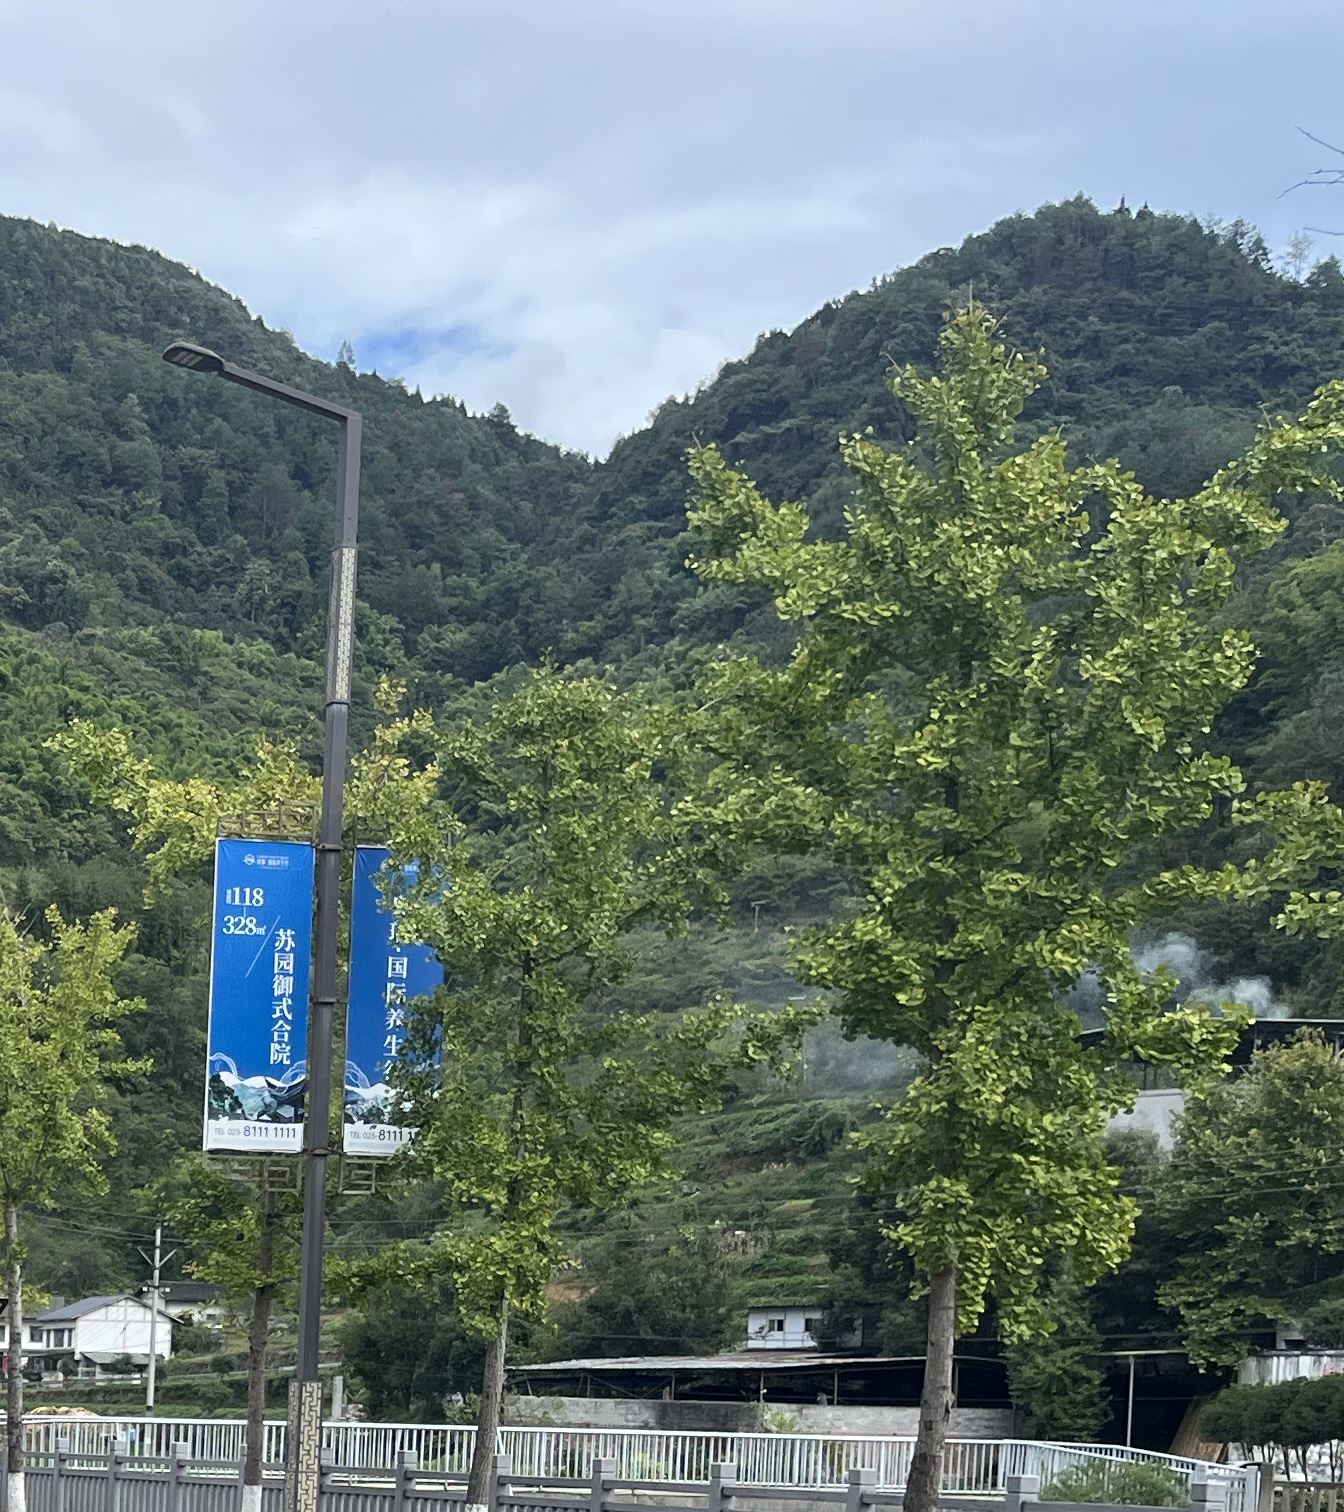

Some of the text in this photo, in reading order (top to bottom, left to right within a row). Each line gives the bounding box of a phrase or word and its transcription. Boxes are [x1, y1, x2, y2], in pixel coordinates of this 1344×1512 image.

[232, 887, 264, 907] 118
[270, 928, 295, 1065] 苏园御式合院
[273, 1126, 296, 1139] 1111
